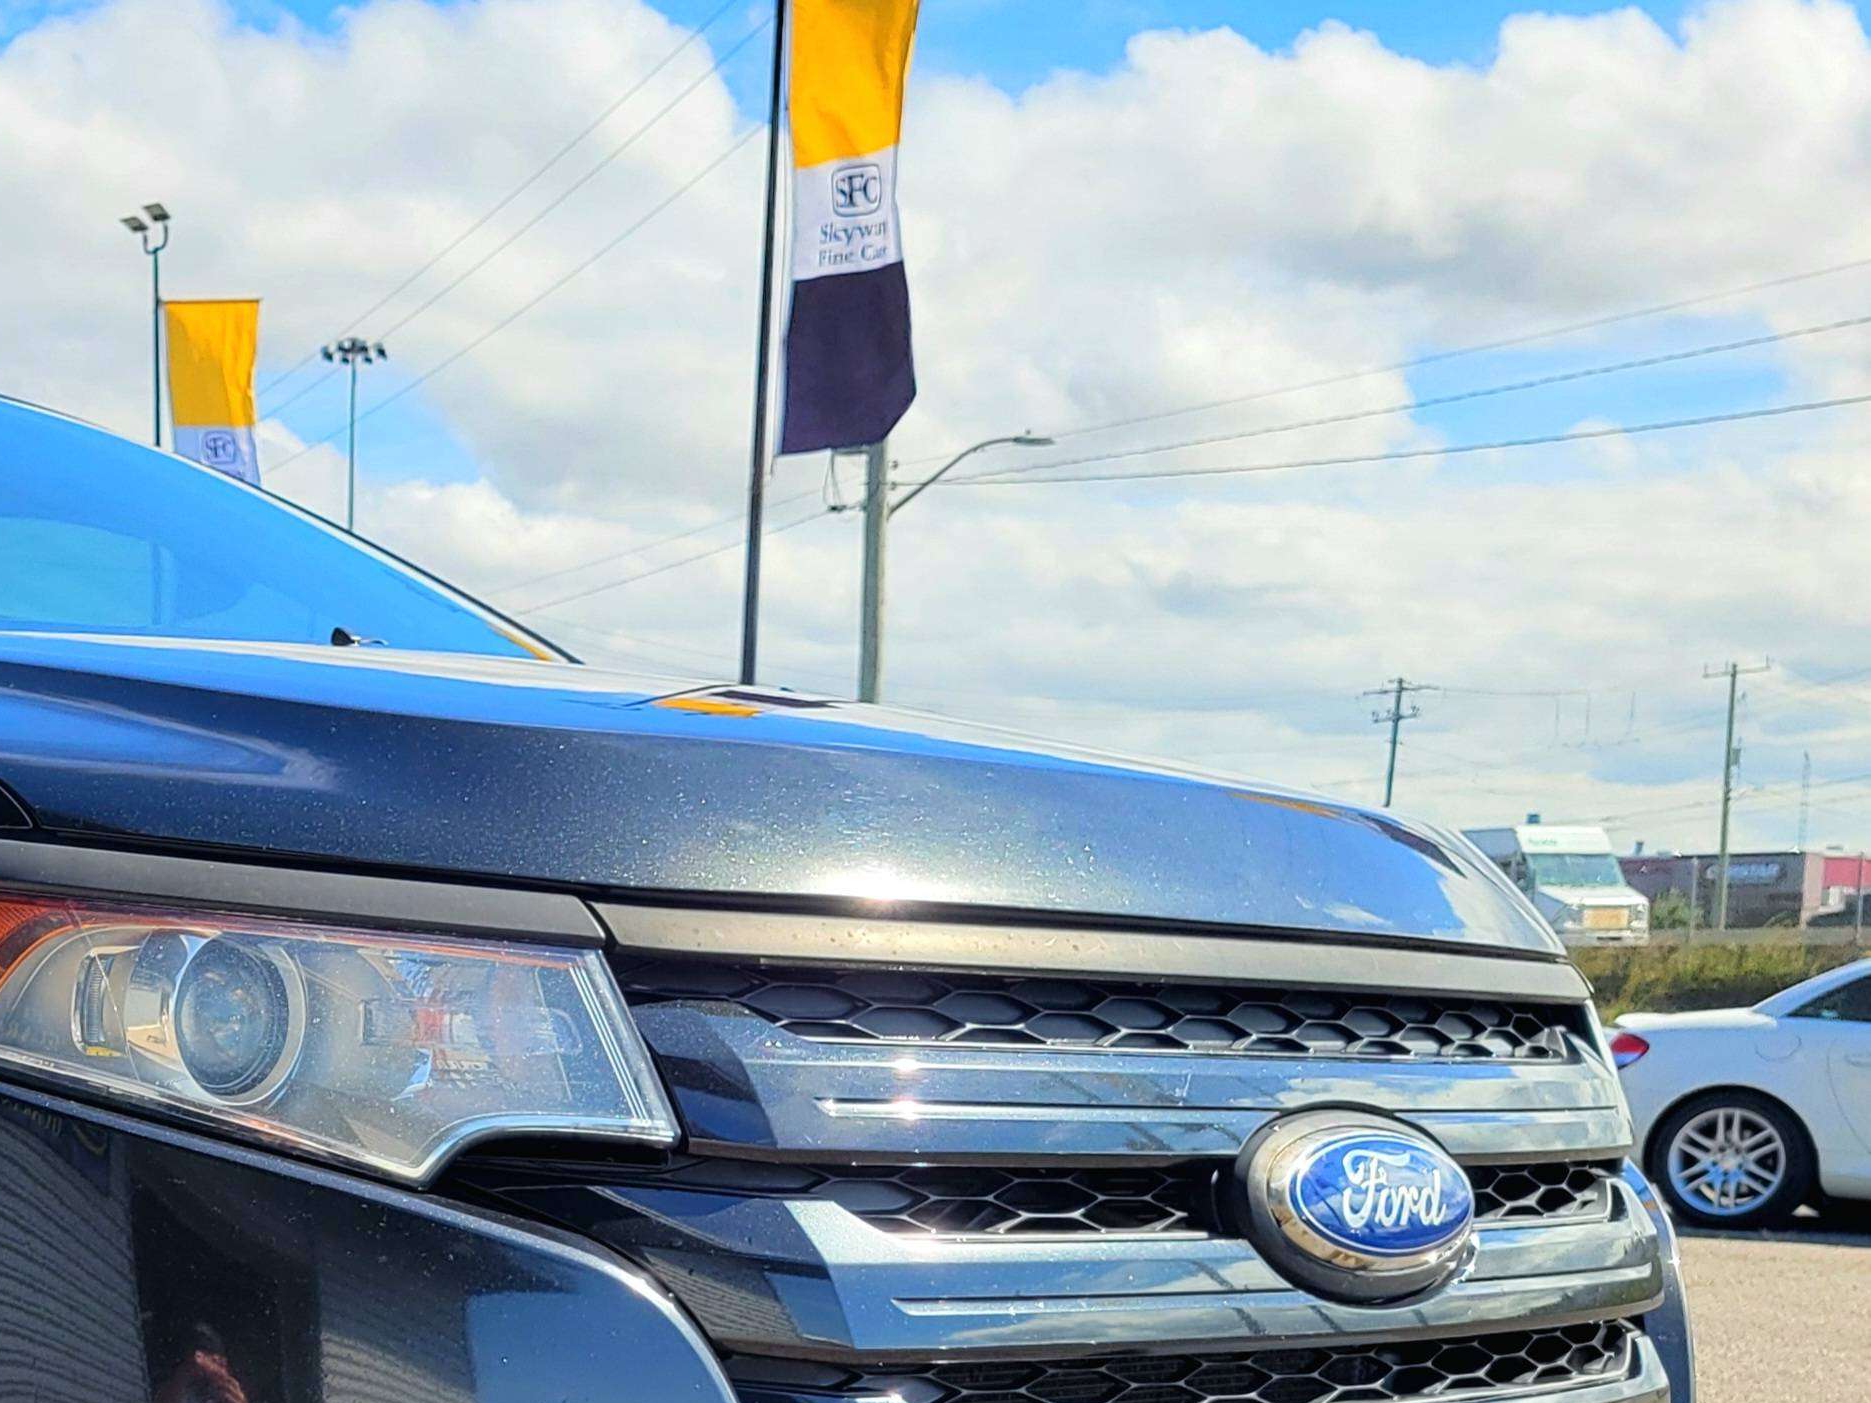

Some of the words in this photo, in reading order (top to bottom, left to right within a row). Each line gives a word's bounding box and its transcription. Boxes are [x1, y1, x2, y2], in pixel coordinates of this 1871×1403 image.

[835, 173, 878, 208] SFC
[818, 249, 854, 267] Fine
[1342, 1148, 1447, 1229] Ford
